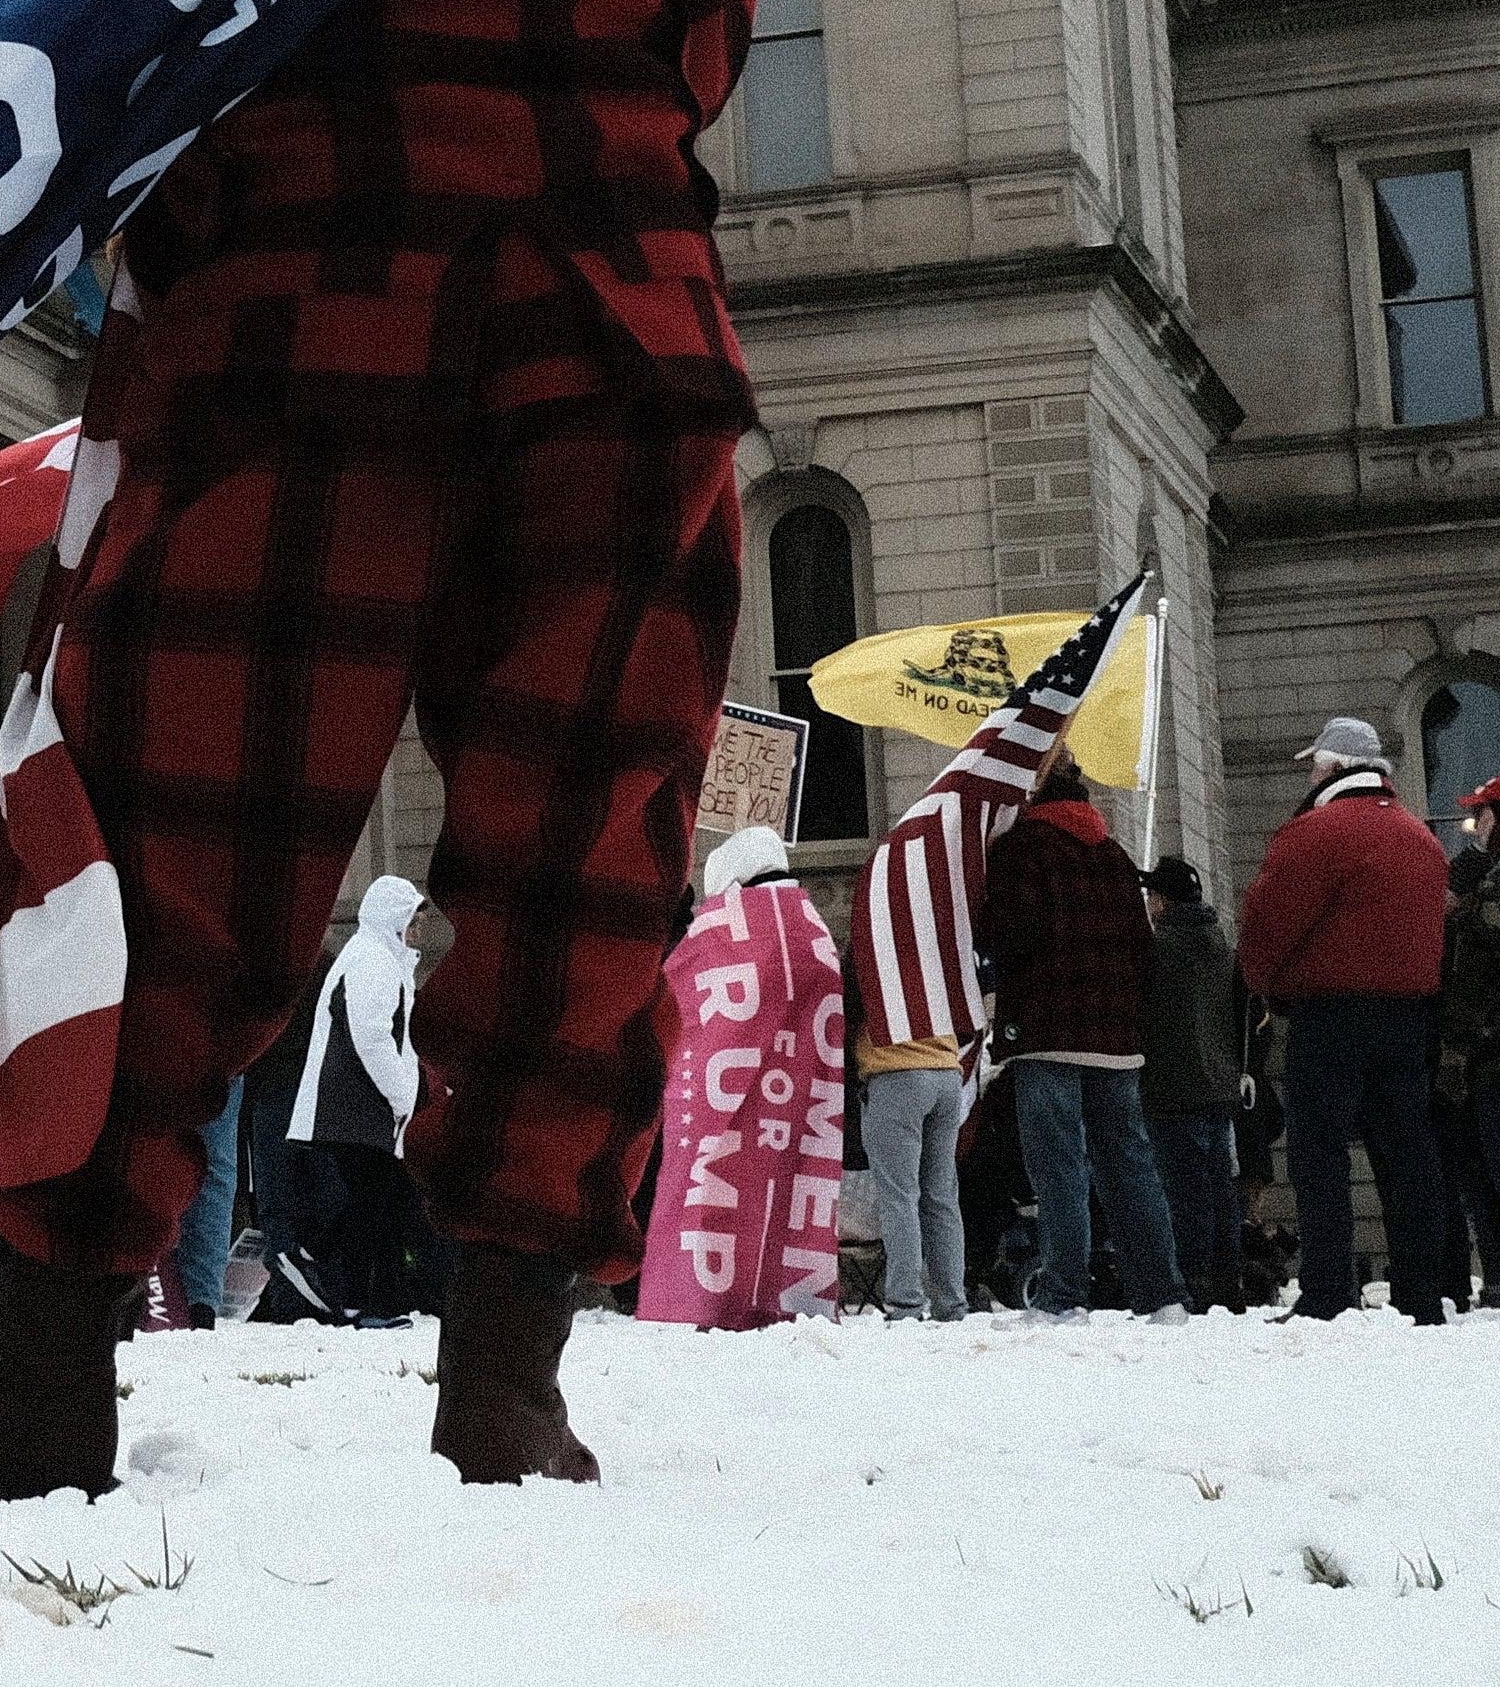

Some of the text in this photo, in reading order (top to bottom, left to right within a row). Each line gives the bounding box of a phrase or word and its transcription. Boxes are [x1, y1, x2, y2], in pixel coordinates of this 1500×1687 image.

[743, 729, 780, 764] THE
[714, 754, 785, 793] PEOPLE
[699, 782, 737, 817] SEE
[680, 882, 762, 1294] TRUMP
[757, 1029, 796, 1152] FOR
